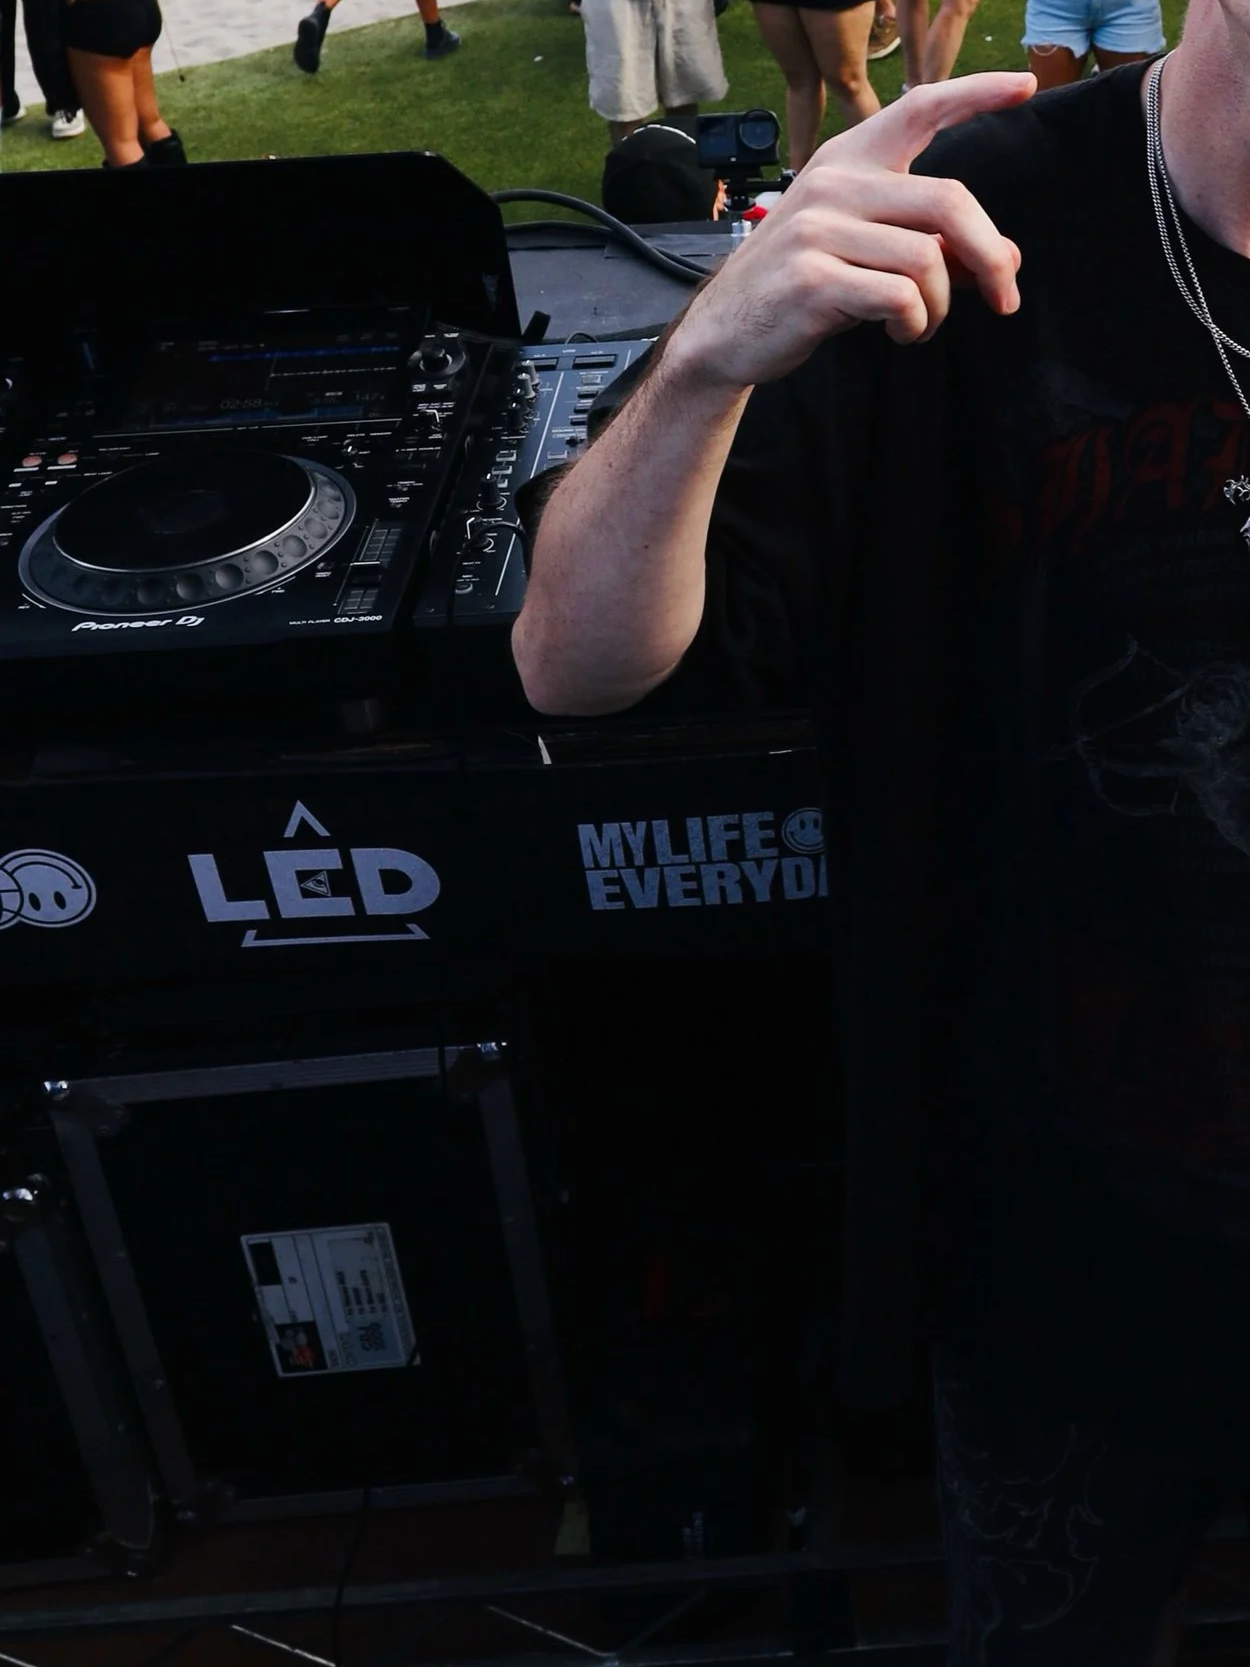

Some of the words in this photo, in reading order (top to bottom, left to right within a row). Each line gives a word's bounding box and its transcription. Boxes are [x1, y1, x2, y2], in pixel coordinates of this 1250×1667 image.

[334, 614, 383, 624] CDJ-3000
[71, 620, 173, 632] Pioneer
[187, 847, 441, 922] LED
